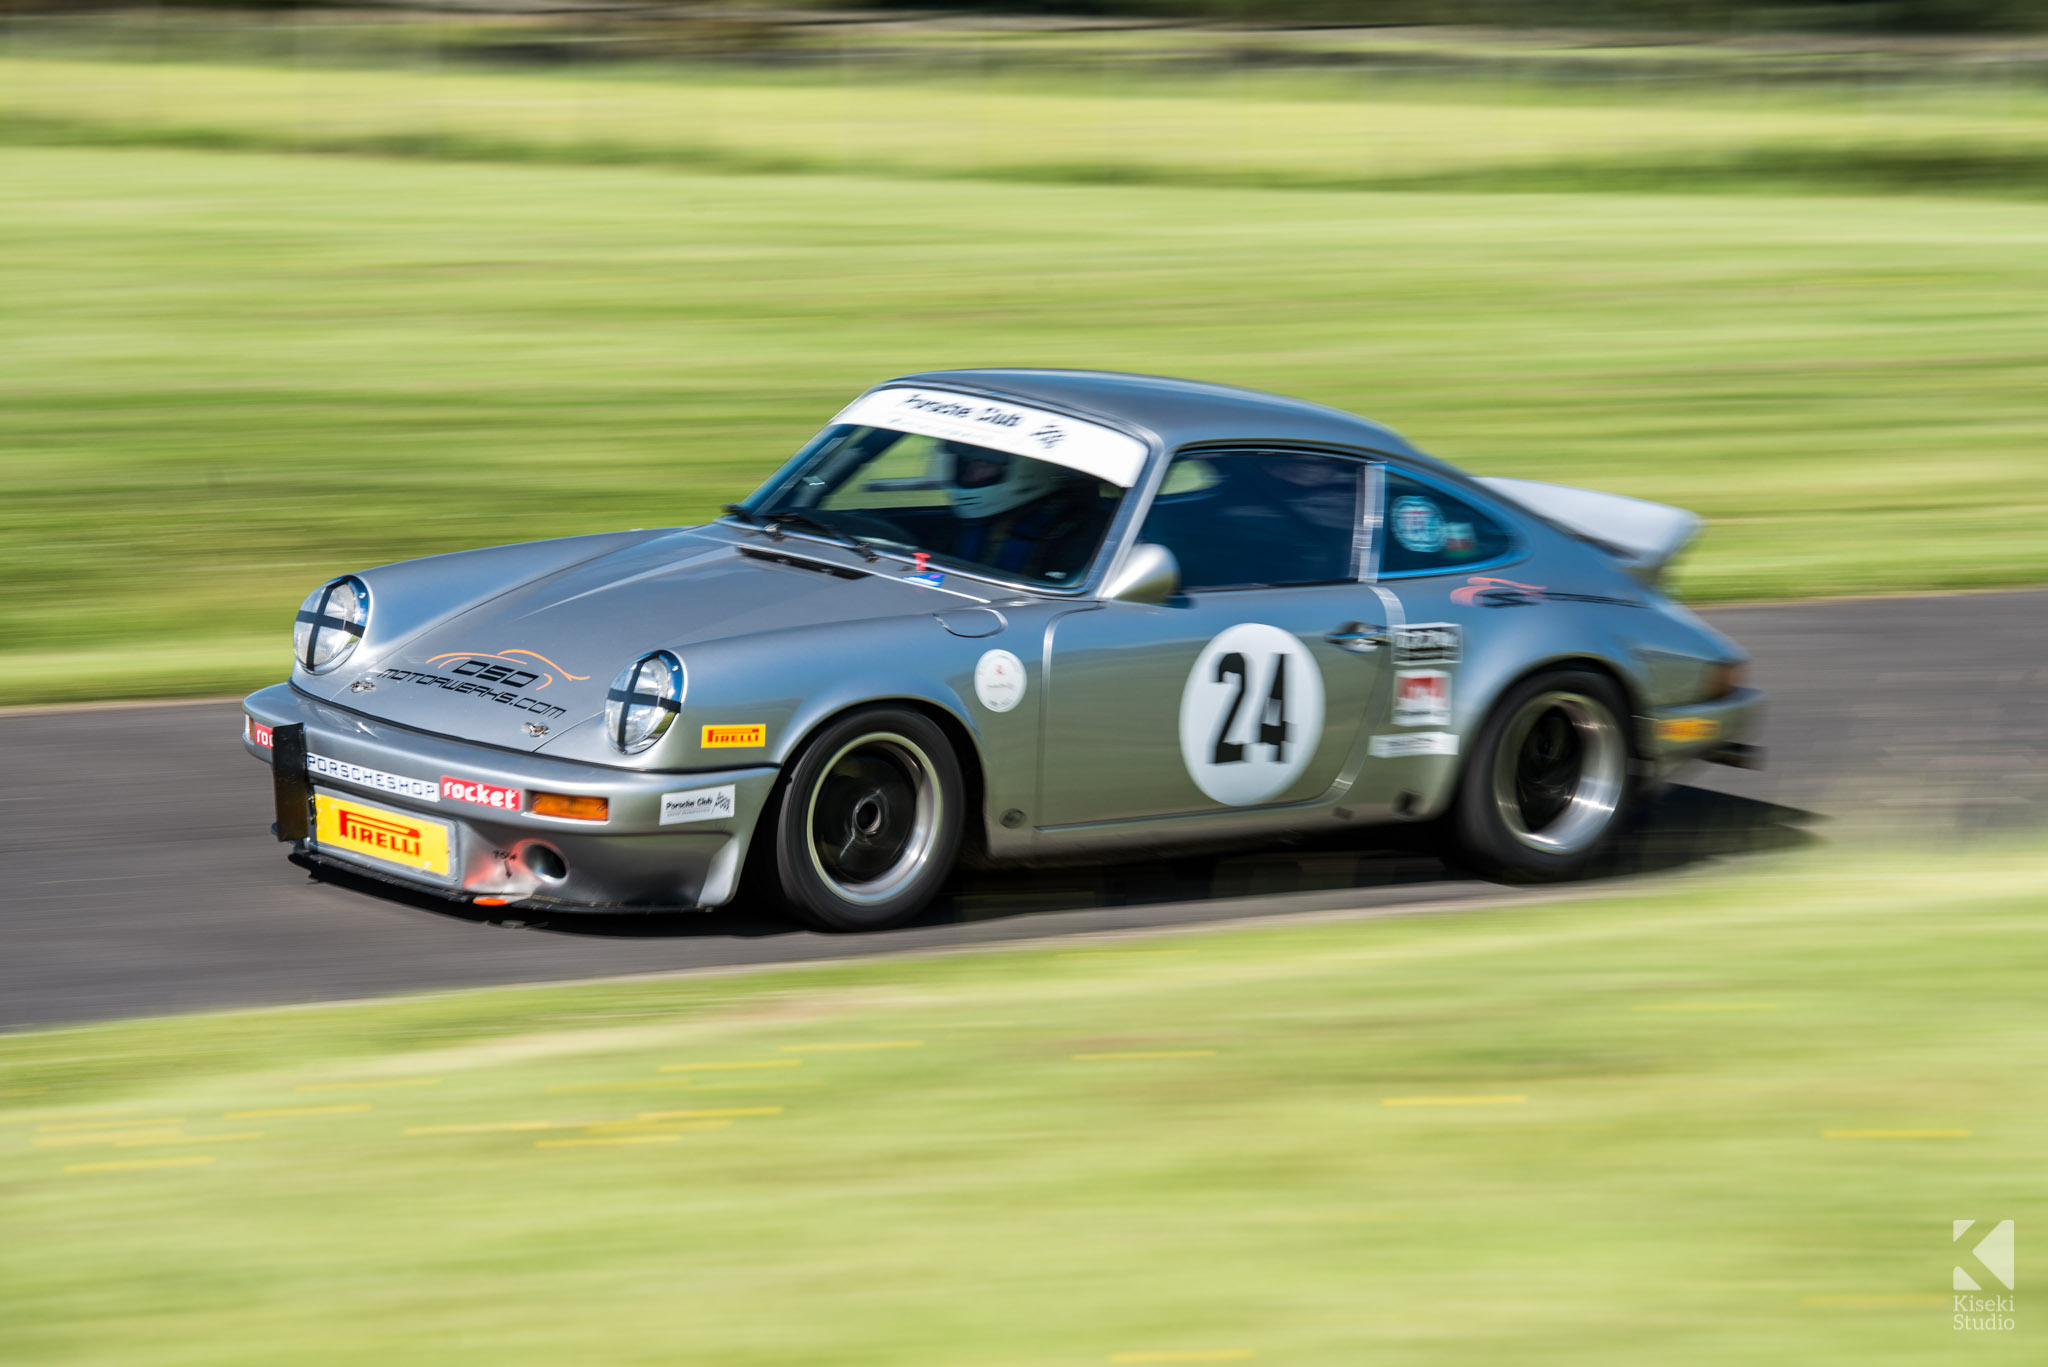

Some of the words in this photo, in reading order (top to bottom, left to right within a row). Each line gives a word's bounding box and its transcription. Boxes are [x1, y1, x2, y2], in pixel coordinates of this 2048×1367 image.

[976, 407, 1024, 427] Club
[377, 668, 567, 719] MOTORWERKS.COM
[1207, 652, 1296, 766] 24
[707, 728, 760, 743] PIRELLI
[307, 755, 436, 796] PORSCHESHOP
[443, 781, 517, 809] rocket
[665, 798, 695, 811] Porsche
[697, 796, 713, 807] Club
[339, 809, 421, 857] PIRELLI
